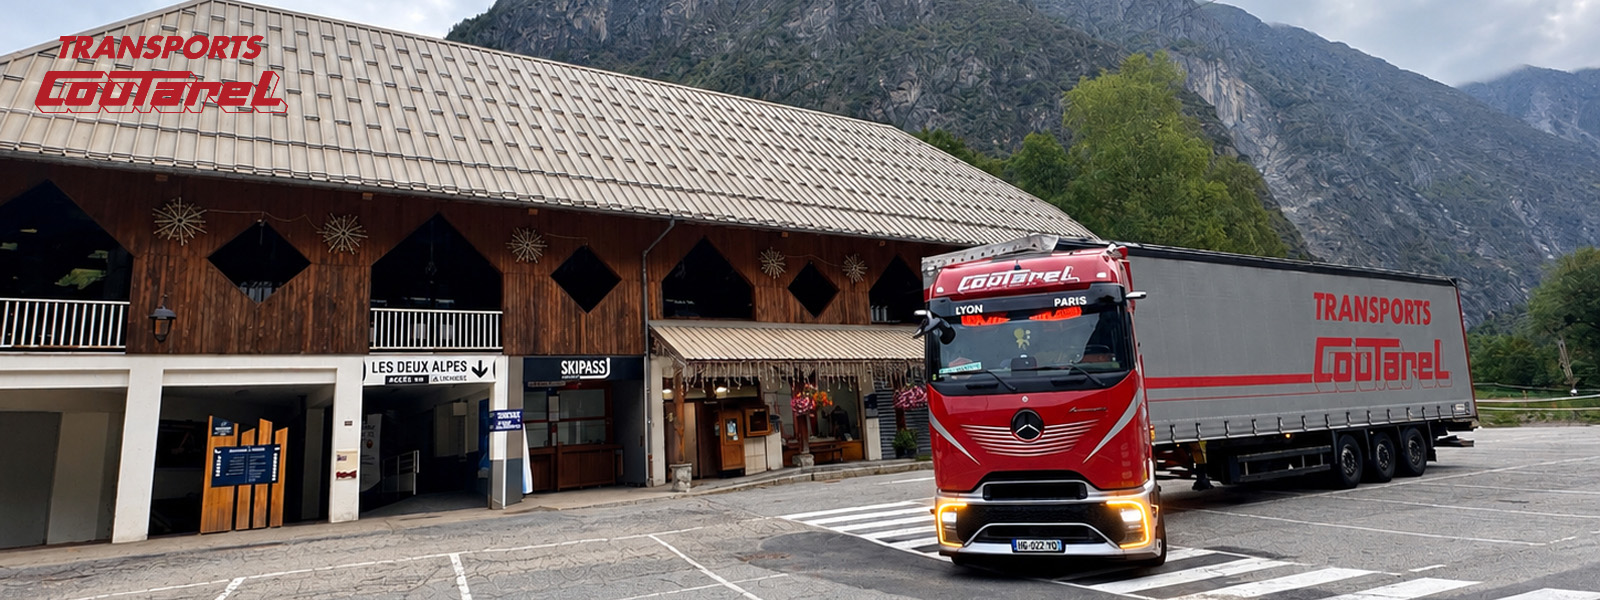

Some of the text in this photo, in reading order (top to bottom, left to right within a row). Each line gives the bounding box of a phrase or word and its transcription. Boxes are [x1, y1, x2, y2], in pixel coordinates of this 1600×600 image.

[1054, 296, 1087, 307] PARIS
[955, 304, 983, 315] LYON
[1313, 292, 1432, 326] TRANSPORTS
[371, 360, 468, 374] LES DEUX ALPES
[560, 360, 606, 375] SKIPASS
